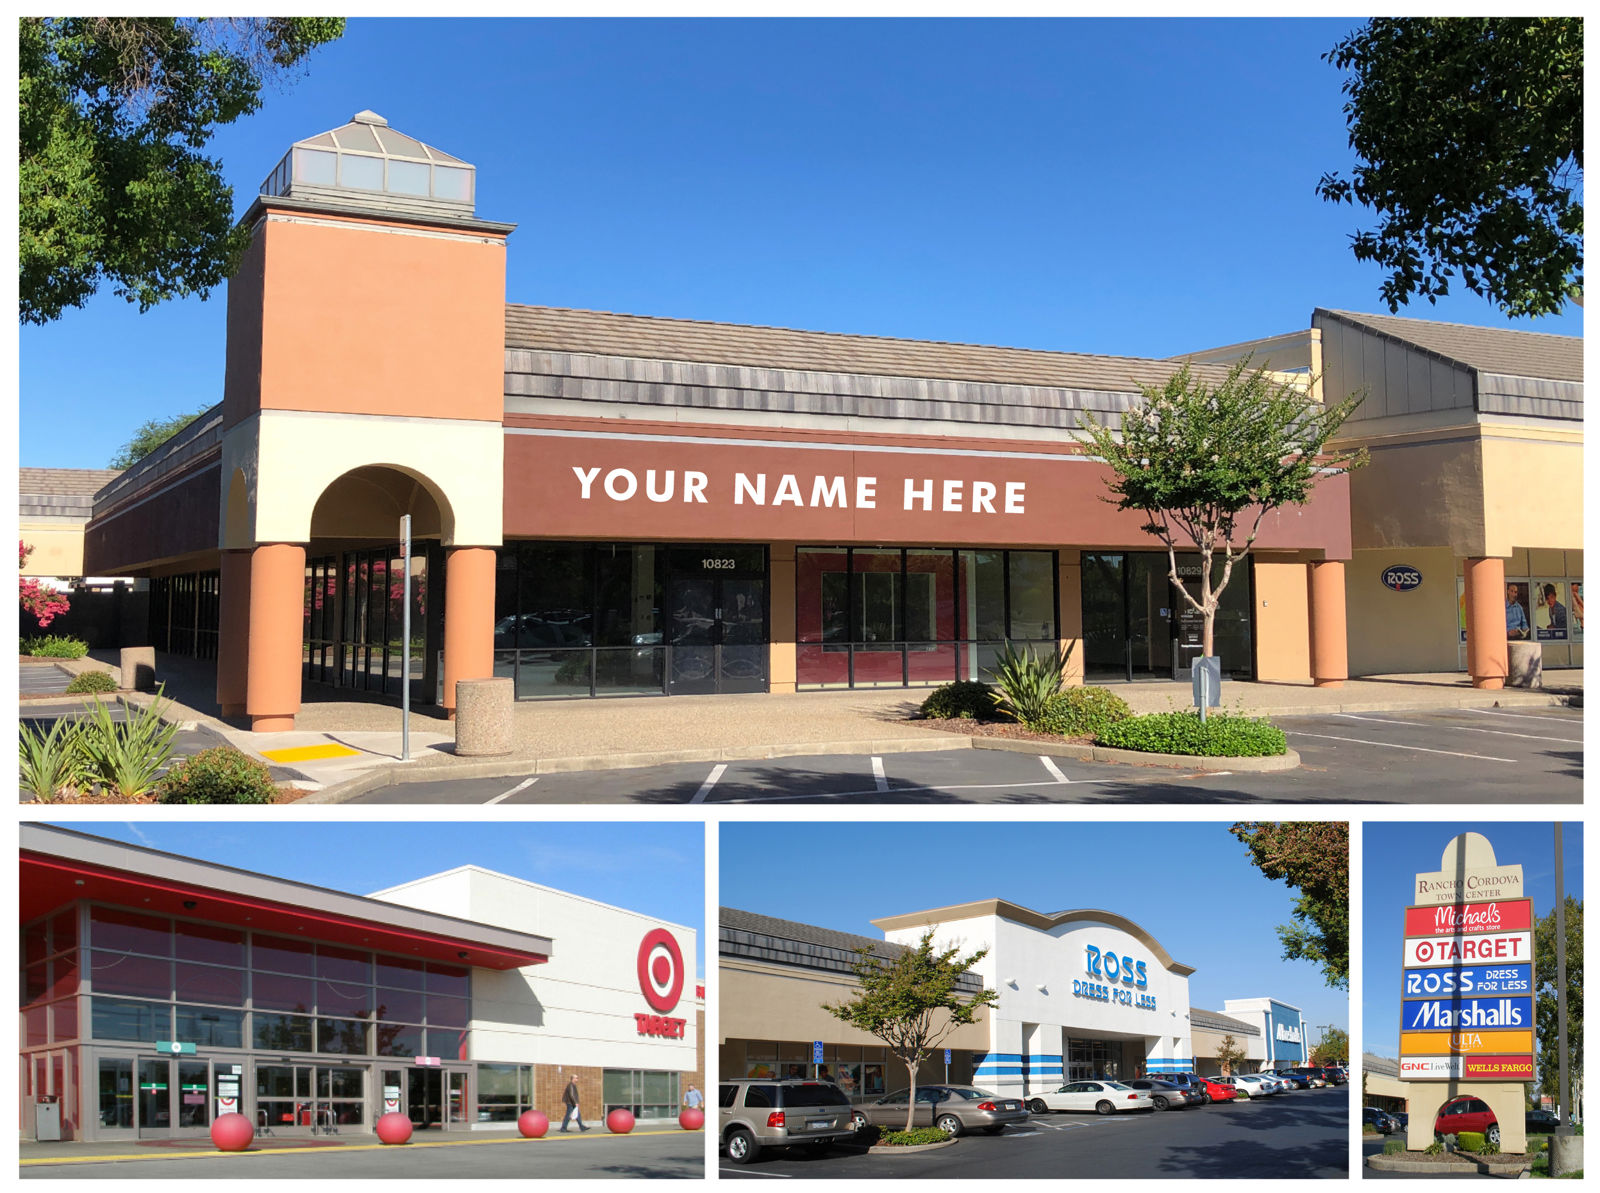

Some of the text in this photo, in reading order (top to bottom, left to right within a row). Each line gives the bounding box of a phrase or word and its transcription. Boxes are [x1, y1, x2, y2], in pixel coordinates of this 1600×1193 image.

[572, 466, 1027, 515] YOUR NAME HERE
[701, 558, 736, 570] 10823
[1177, 566, 1202, 576] 10829
[1387, 571, 1420, 585] ROSS
[1418, 875, 1520, 894] RANCHO CORDOVA
[1436, 889, 1501, 901] TOWN CENTER
[1435, 902, 1501, 926] Michaels
[1445, 926, 1456, 934] arts
[1457, 925, 1468, 933] and
[1469, 924, 1485, 932] crafts
[1437, 938, 1522, 959] TARGET
[1087, 944, 1148, 986] ROSS
[1486, 969, 1519, 980] DRESS
[1407, 971, 1474, 994] ROSS
[1477, 980, 1528, 991] FOR LESS
[1073, 979, 1156, 1008] DRESS FOR LESS
[1412, 999, 1522, 1028] Marshalls
[634, 1013, 687, 1038] TARGET
[1453, 1033, 1482, 1045] ULTA
[1401, 1062, 1430, 1071] GNC
[1467, 1063, 1533, 1072] WELLS FARGO
